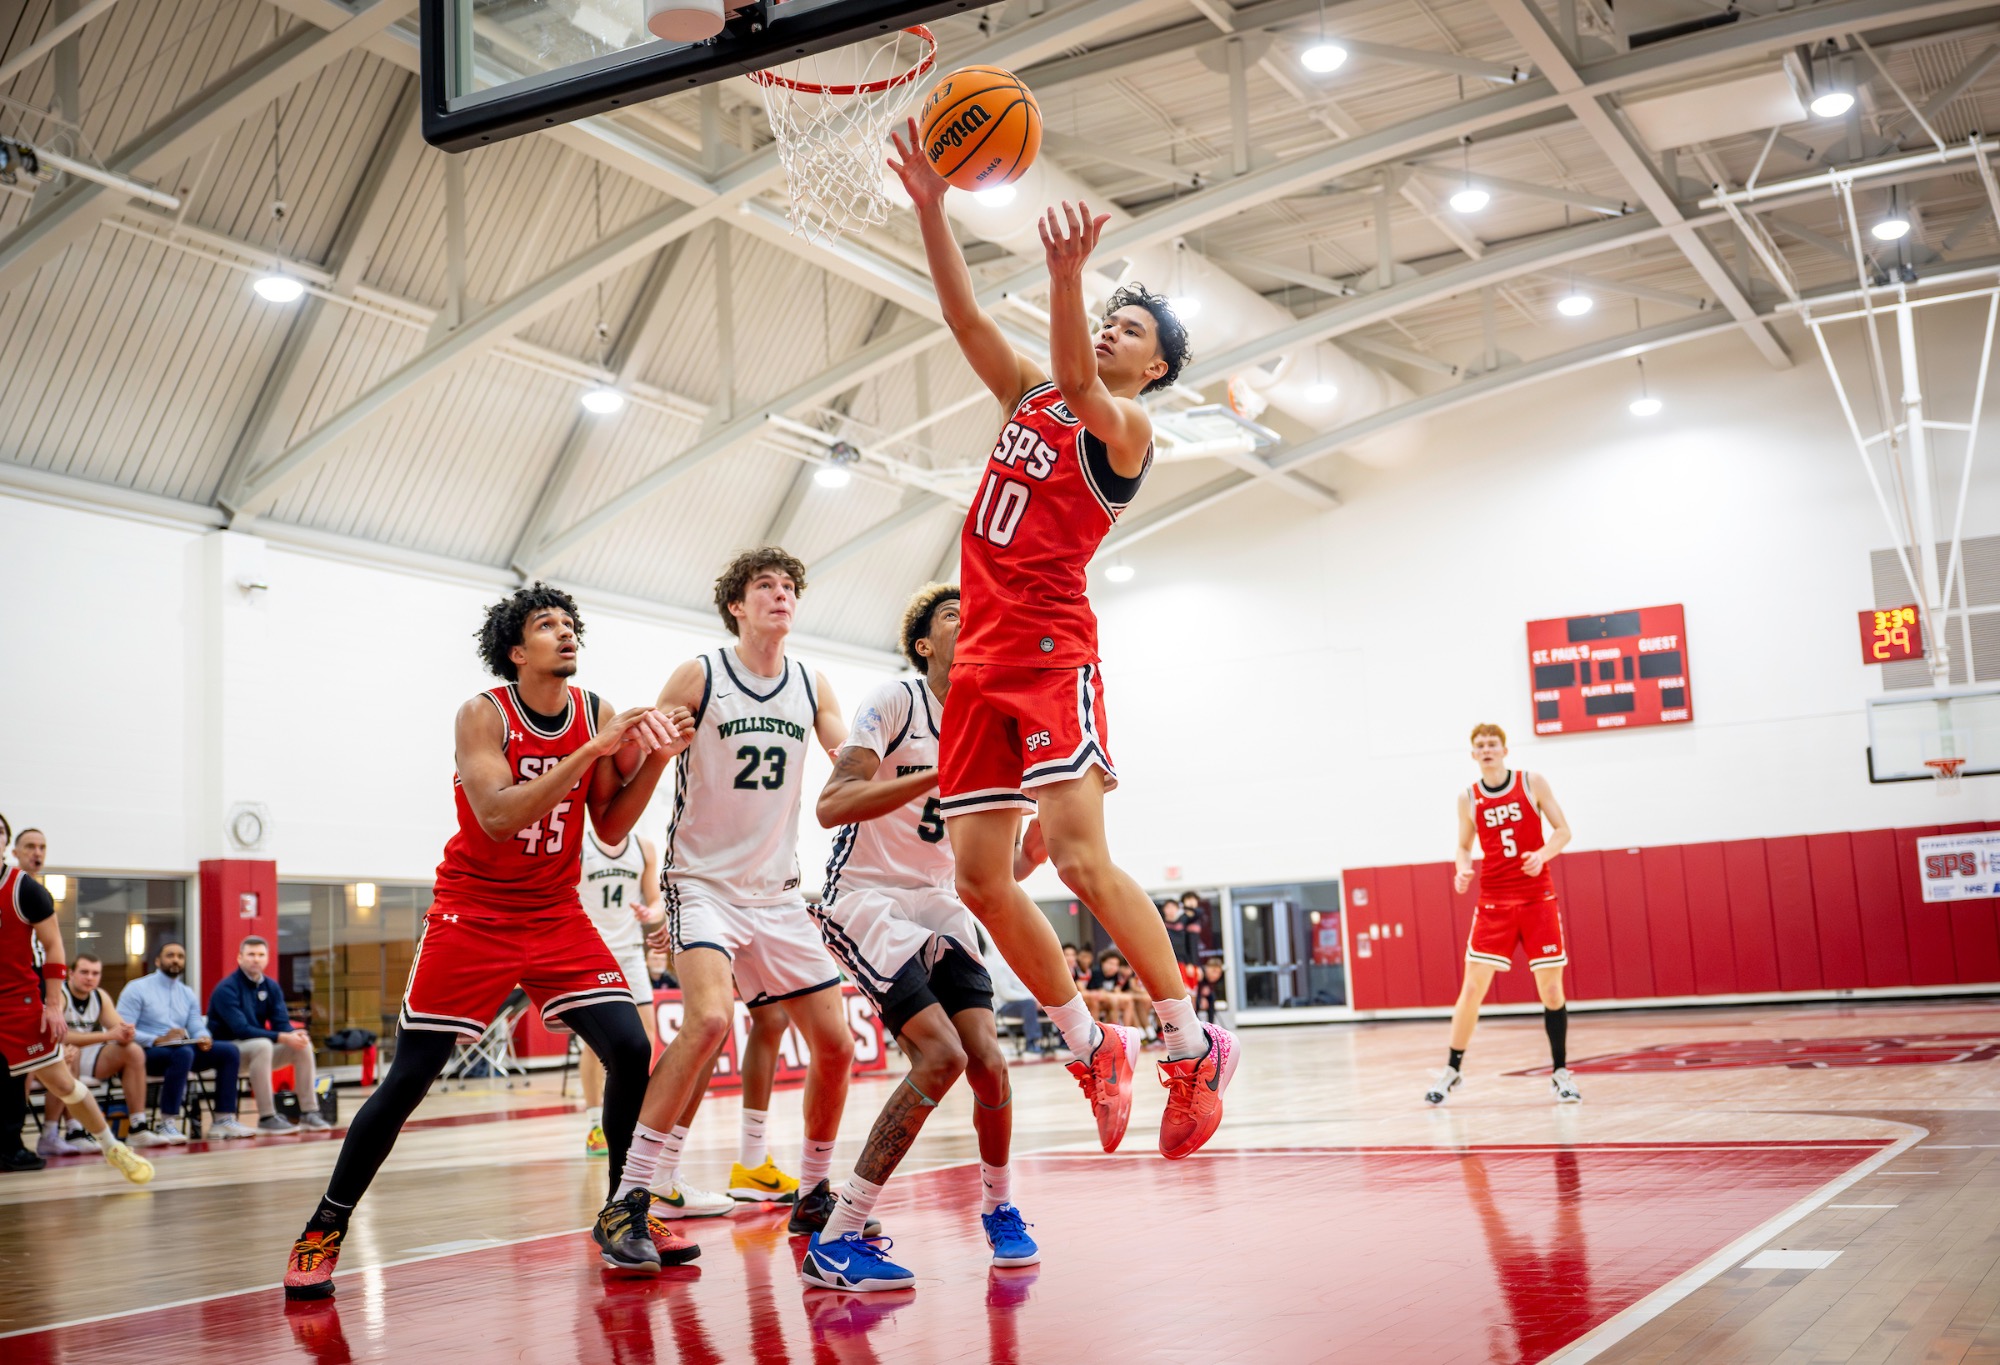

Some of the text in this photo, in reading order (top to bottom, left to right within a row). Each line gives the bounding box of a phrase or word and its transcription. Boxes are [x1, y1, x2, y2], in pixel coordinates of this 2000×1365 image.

[928, 104, 992, 163] Wilson
[991, 420, 1060, 482] SPS
[973, 470, 1032, 549] 10
[1874, 607, 1915, 630] 3:39
[1532, 645, 1590, 664] ST. PAUL'S
[1638, 635, 1677, 652] GUEST
[1873, 626, 1911, 659] 29
[717, 717, 805, 743] WILLISTON
[1025, 730, 1051, 752] SPS
[733, 745, 787, 790] 23
[917, 796, 945, 844] 5
[1483, 802, 1523, 828] SPS
[515, 800, 573, 857] 45
[1500, 828, 1518, 858] 5
[1925, 851, 1978, 879] SPS
[602, 884, 623, 909] 14
[1542, 944, 1558, 954] SPS
[597, 971, 623, 985] SPS
[27, 1042, 45, 1056] SPS
